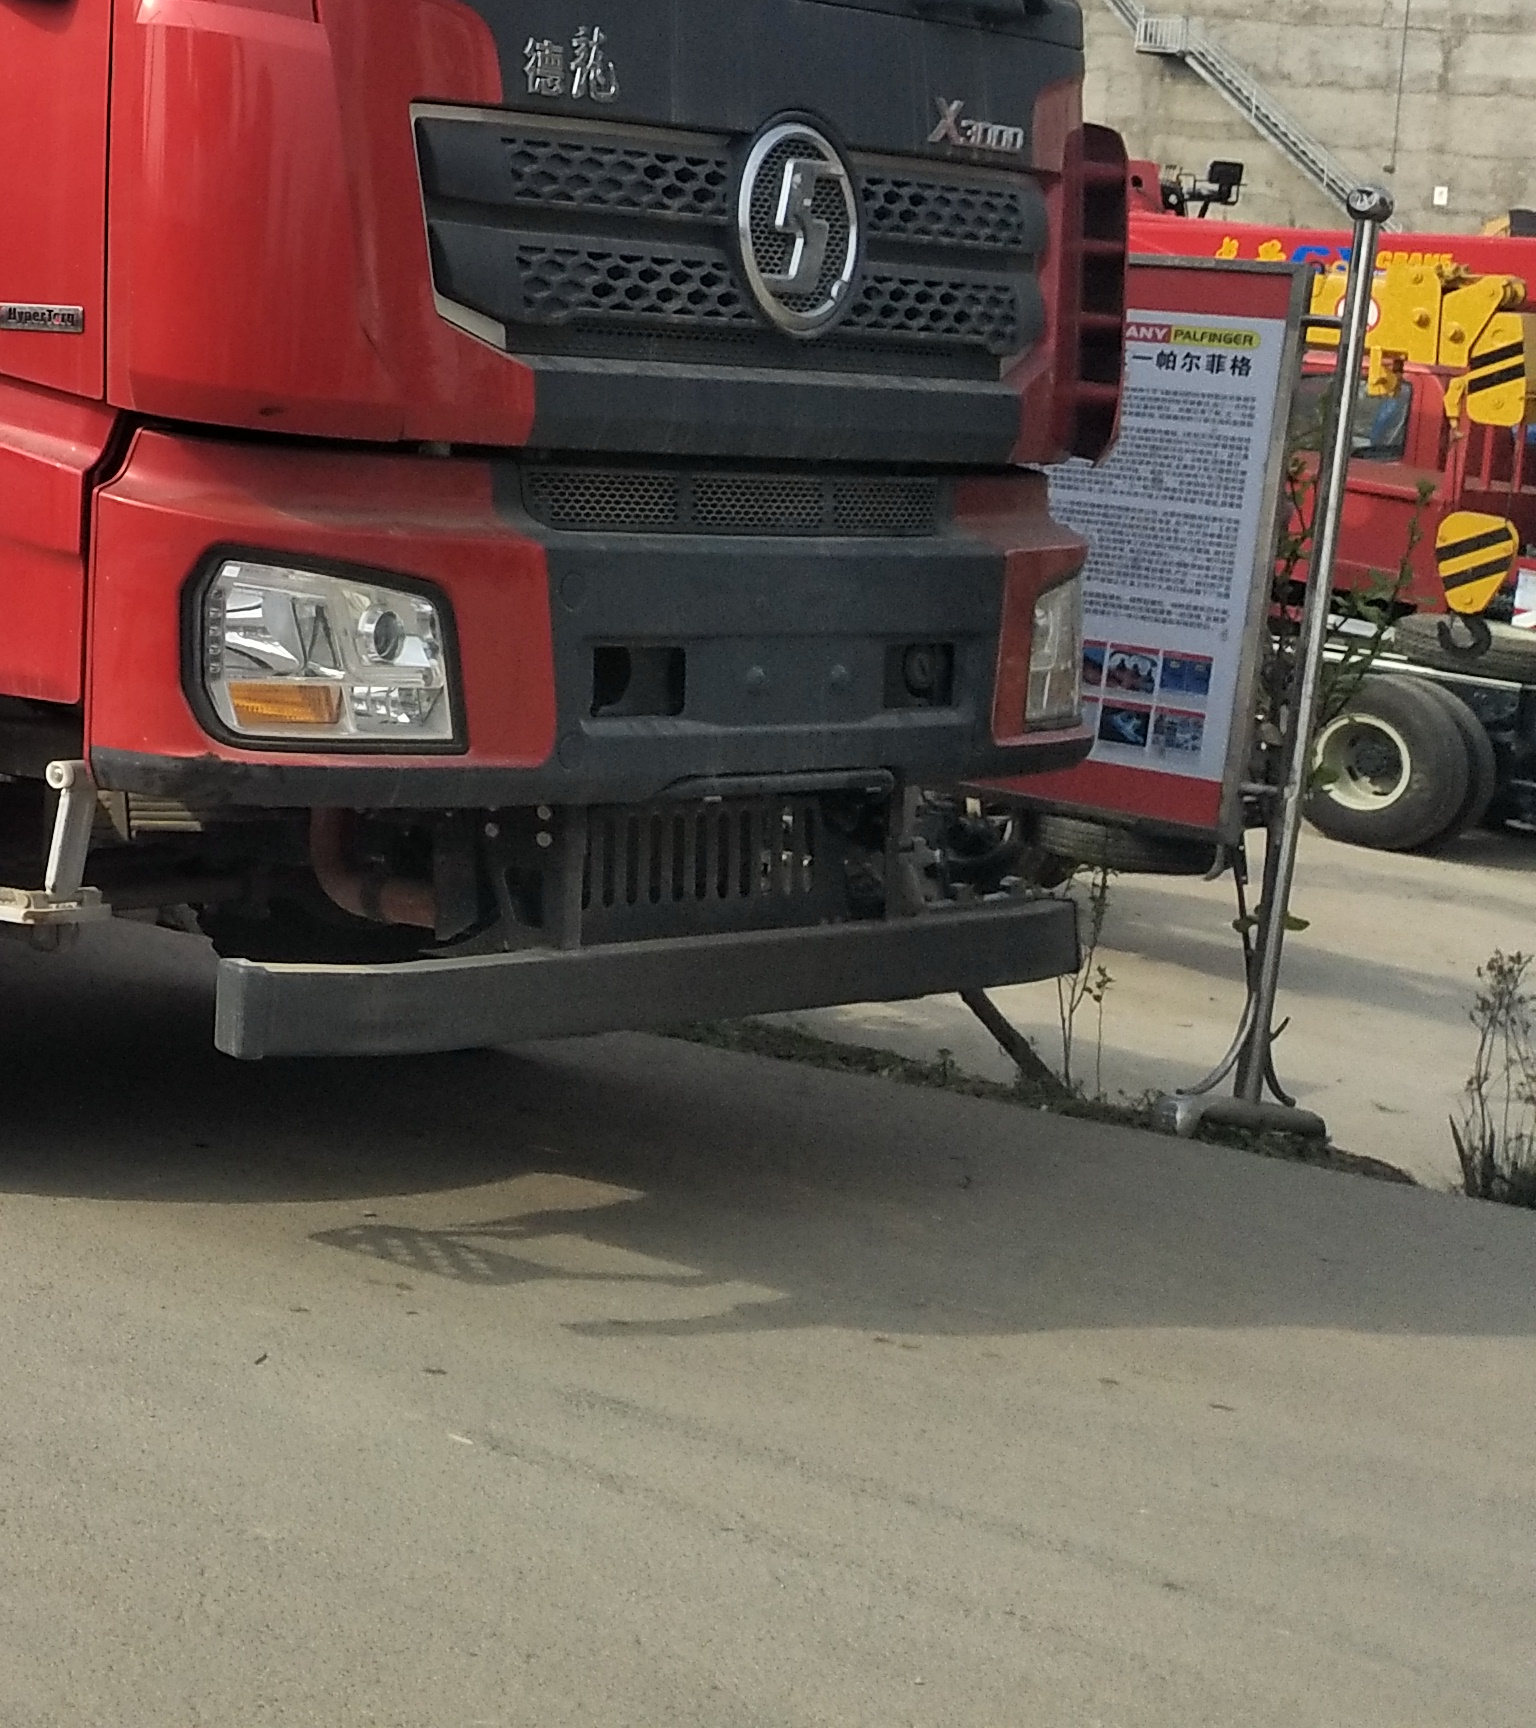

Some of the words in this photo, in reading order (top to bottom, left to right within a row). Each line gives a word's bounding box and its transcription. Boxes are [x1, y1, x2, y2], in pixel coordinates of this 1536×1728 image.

[927, 97, 1024, 152] X3000
[1173, 329, 1254, 346] PALFINGER
[1124, 349, 1252, 377] 一帕尔菲格
